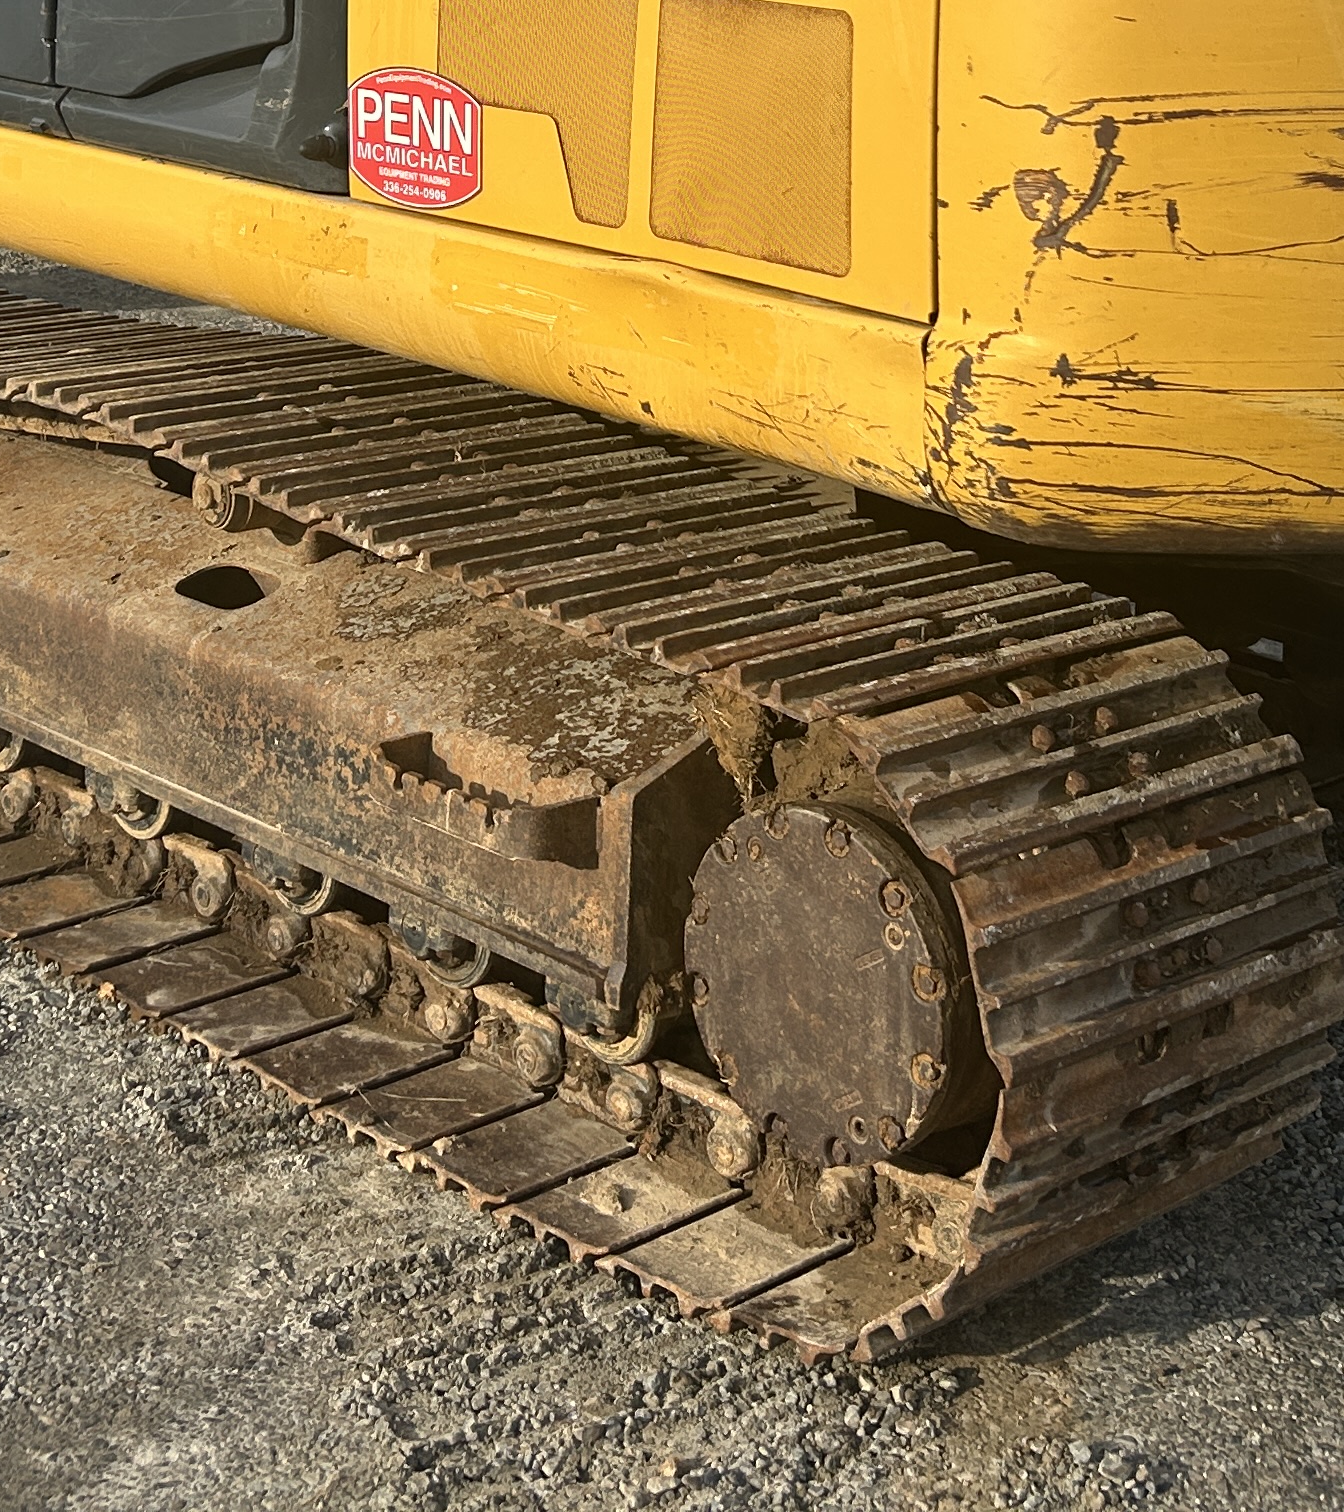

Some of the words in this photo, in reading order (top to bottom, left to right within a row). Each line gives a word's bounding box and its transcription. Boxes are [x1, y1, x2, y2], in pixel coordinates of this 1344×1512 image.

[357, 88, 473, 155] PENN
[357, 140, 474, 177] MCMICHAEL
[378, 166, 419, 182] EQUIPMENT
[419, 173, 451, 187] TRADING
[383, 179, 447, 202] 336-254-0906
